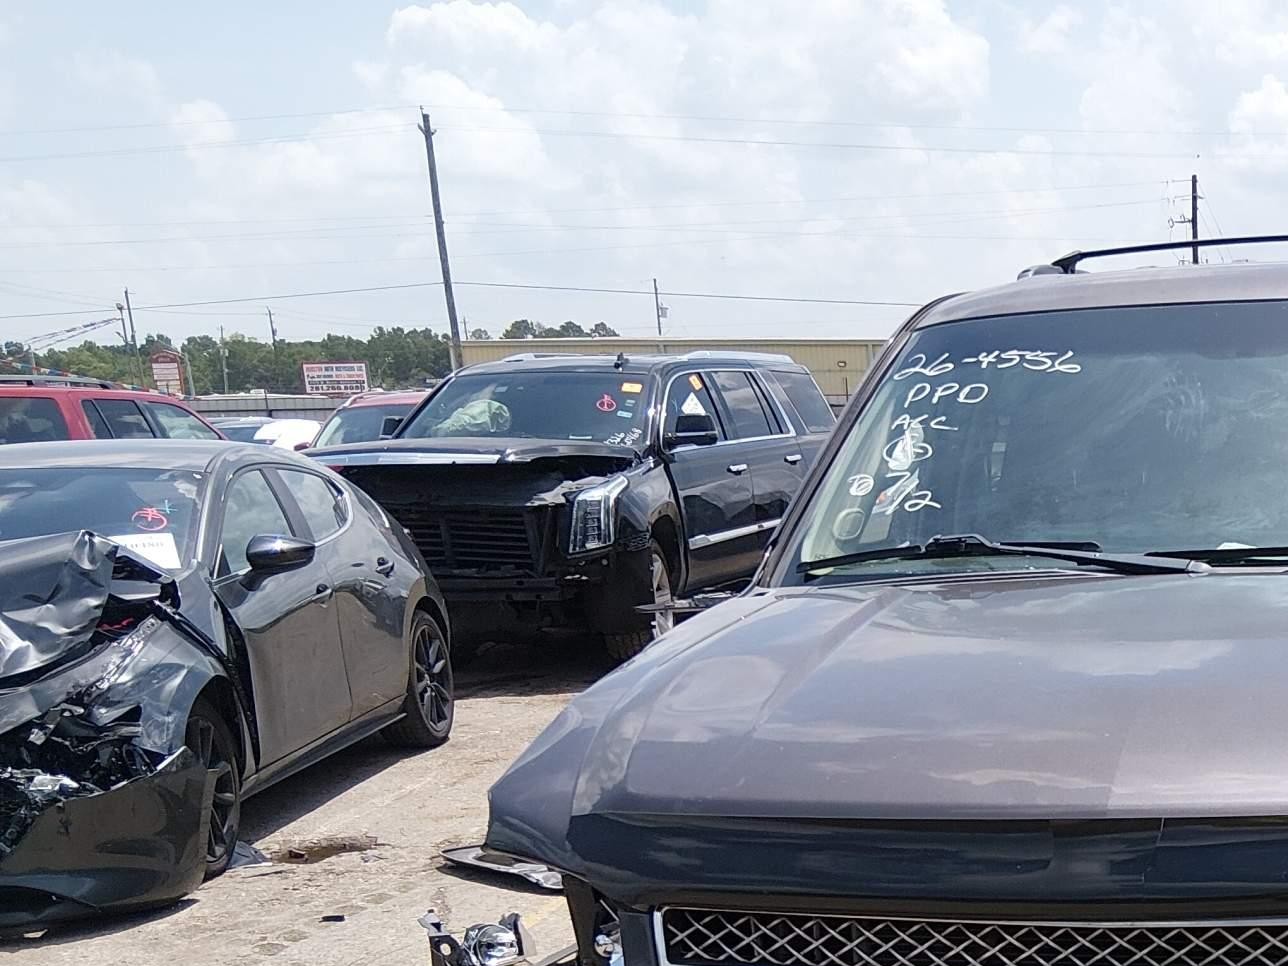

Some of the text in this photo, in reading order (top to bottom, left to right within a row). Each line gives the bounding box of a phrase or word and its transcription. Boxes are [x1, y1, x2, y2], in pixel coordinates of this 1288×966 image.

[893, 350, 1082, 381] 26-4556
[904, 383, 990, 409] PPD
[891, 413, 960, 431] ACC
